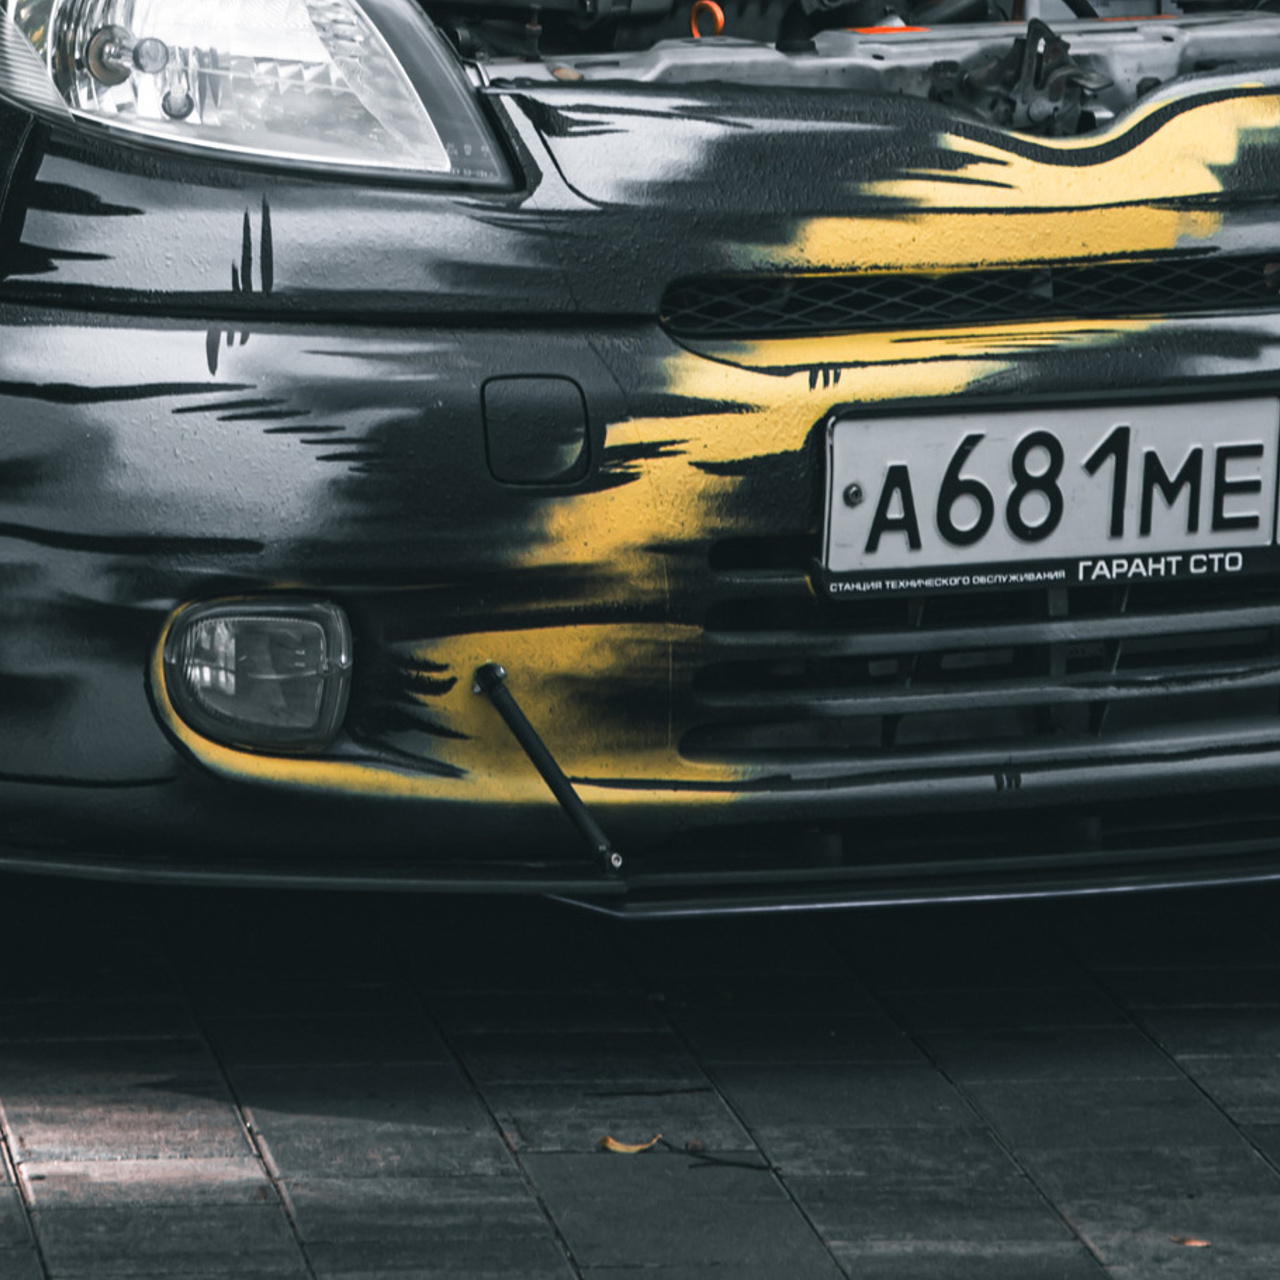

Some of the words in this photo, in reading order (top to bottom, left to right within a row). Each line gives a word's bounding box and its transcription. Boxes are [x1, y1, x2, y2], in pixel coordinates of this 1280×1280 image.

[829, 580, 883, 593] СТАНЦИЯ
[885, 576, 970, 590] ТЕХНИЧЕСКОГО
[972, 569, 1067, 585] ОБСЛУЖИВАНИЯ
[1078, 554, 1183, 581] ГАРАНТ
[1189, 551, 1243, 574] СТО
